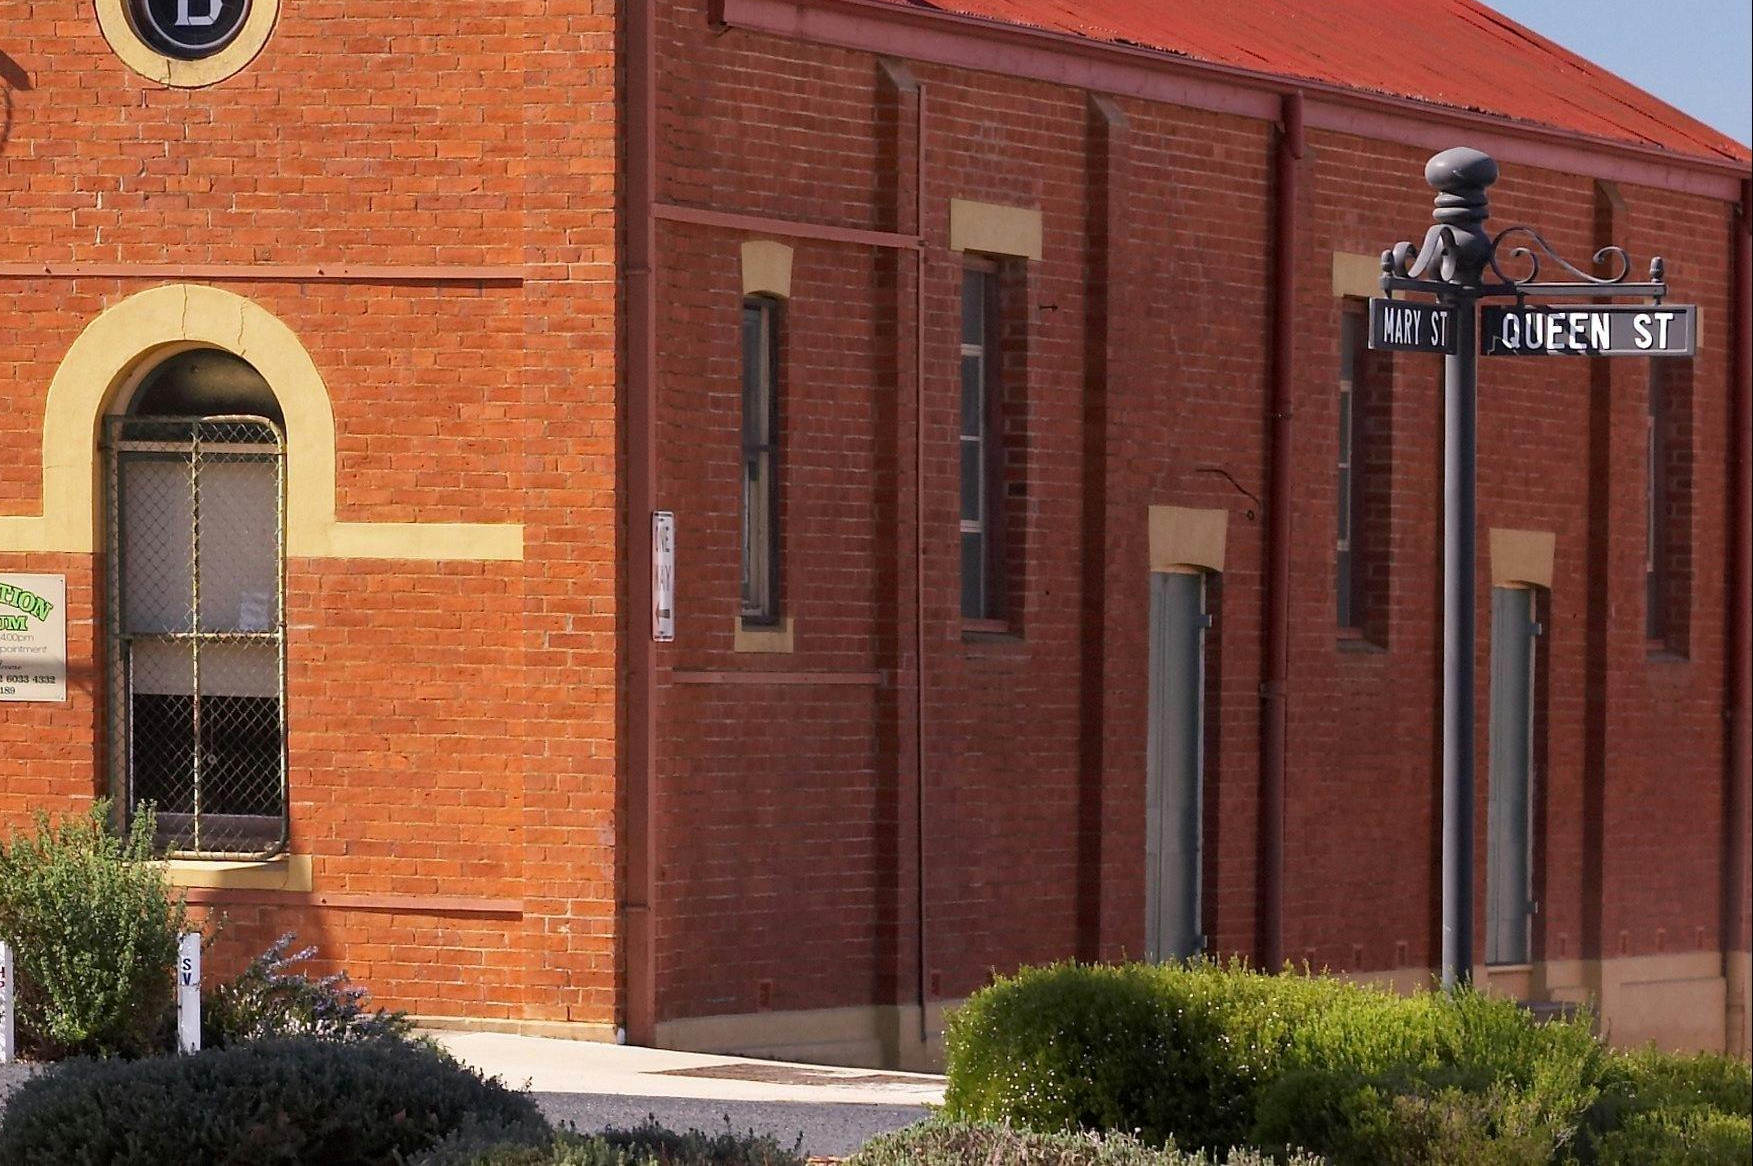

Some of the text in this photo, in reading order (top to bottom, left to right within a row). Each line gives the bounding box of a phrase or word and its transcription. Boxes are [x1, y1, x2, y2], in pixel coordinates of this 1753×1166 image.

[1383, 306, 1447, 347] MARY ST
[1502, 312, 1674, 351] QUEEN ST
[6, 674, 30, 683] 6033
